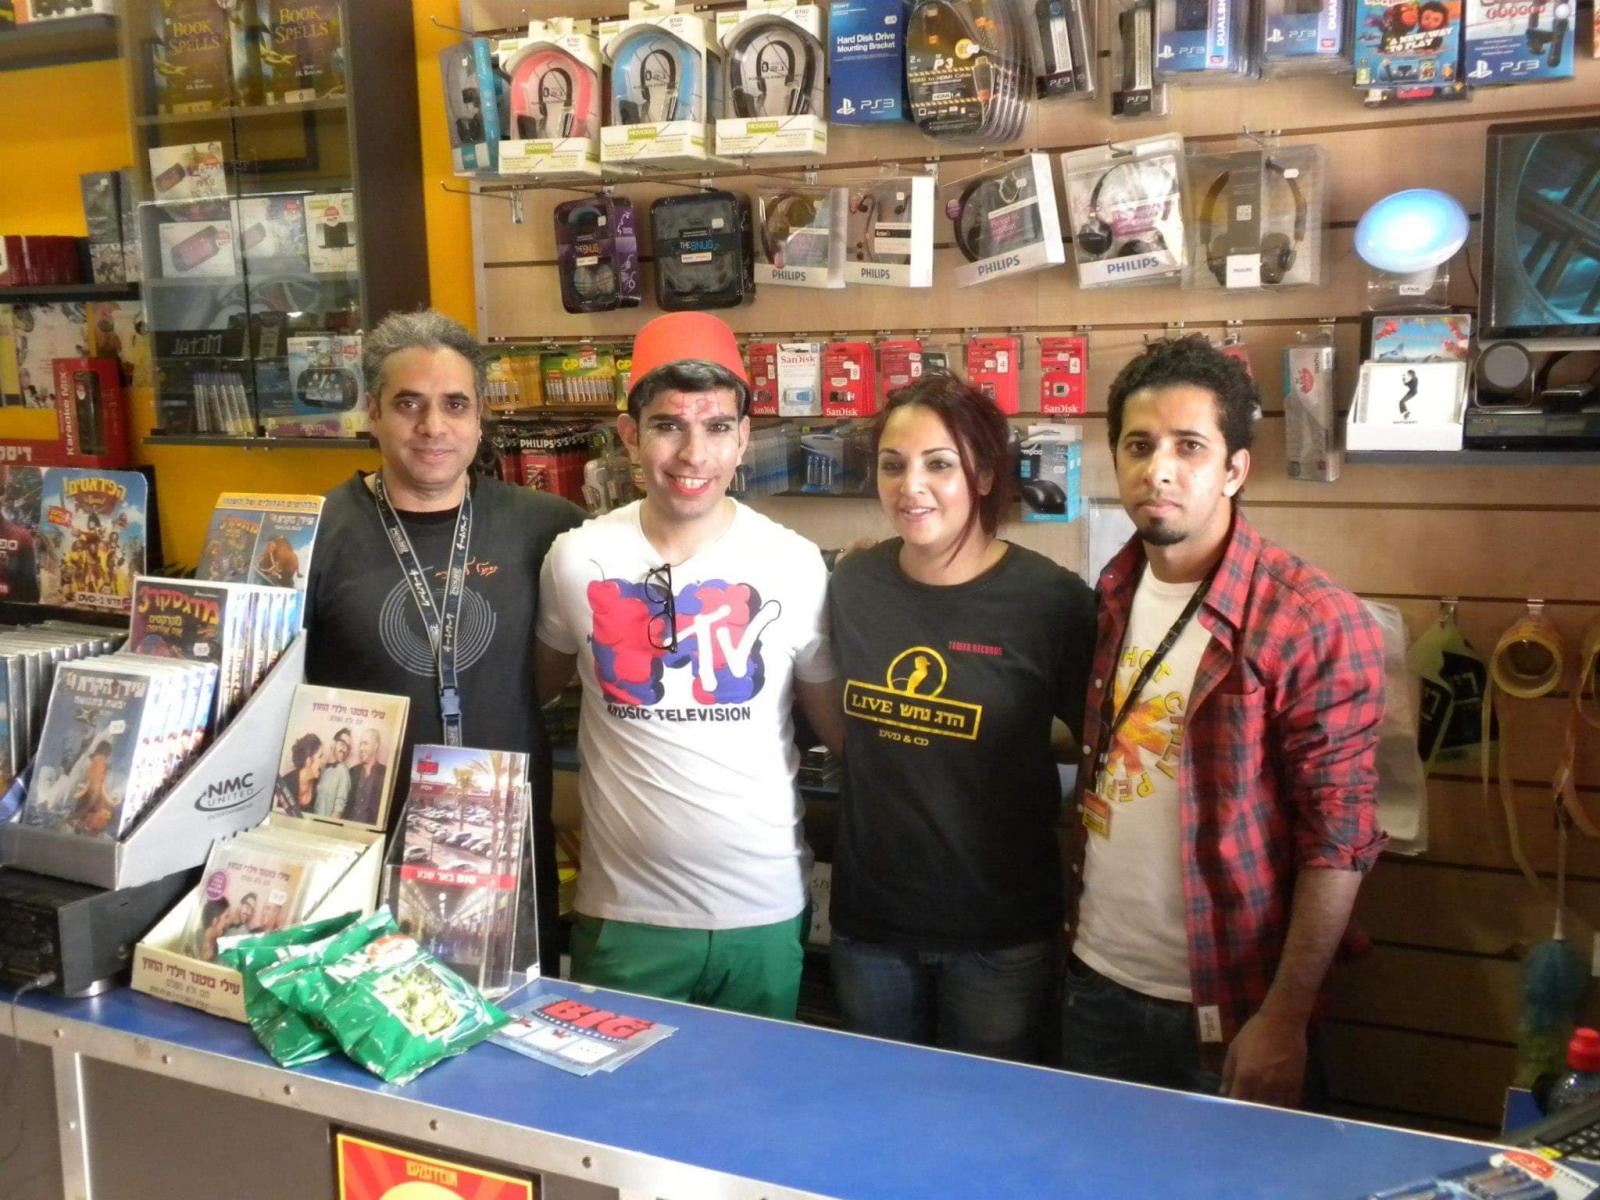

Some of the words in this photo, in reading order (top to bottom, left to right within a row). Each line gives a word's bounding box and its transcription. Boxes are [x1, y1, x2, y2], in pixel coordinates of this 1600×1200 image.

[280, 7, 321, 24] BOOK
[173, 21, 212, 36] BOOK
[275, 22, 328, 44] SPELLS
[837, 36, 856, 44] Hard
[857, 35, 873, 43] Disk
[874, 32, 896, 41] Drive
[1288, 31, 1317, 39] PS3
[837, 44, 868, 53] Mounting
[869, 42, 896, 50] Bracket
[1178, 46, 1206, 55] PS3
[1500, 59, 1540, 72] PS3
[1049, 78, 1071, 86] PS3
[860, 98, 895, 110] PS3
[1126, 96, 1149, 104] PS3
[977, 255, 1020, 276] PHILIPS
[1106, 256, 1160, 274] PHILIPS
[771, 269, 806, 281] PHILIPS
[861, 267, 890, 279] PHILIPS
[562, 359, 579, 371] GP
[780, 355, 816, 364] SanDisk
[753, 406, 776, 415] SanDisk
[826, 407, 858, 417] SanDisk
[1044, 404, 1079, 413] SanDisk
[64, 399, 75, 456] Karaoke
[520, 437, 554, 449] PHILIPS
[851, 694, 893, 714] LIVE
[608, 704, 652, 719] MUSIC
[655, 708, 751, 721] TELEVISION
[900, 703, 931, 723] נחש
[934, 711, 965, 728] הדג
[879, 729, 901, 741] DVD
[903, 734, 912, 743] &
[913, 737, 929, 747] CD
[207, 772, 254, 799] NMC
[207, 787, 254, 807] UNITED
[456, 874, 477, 884] BIG
[536, 999, 657, 1041] BIG
